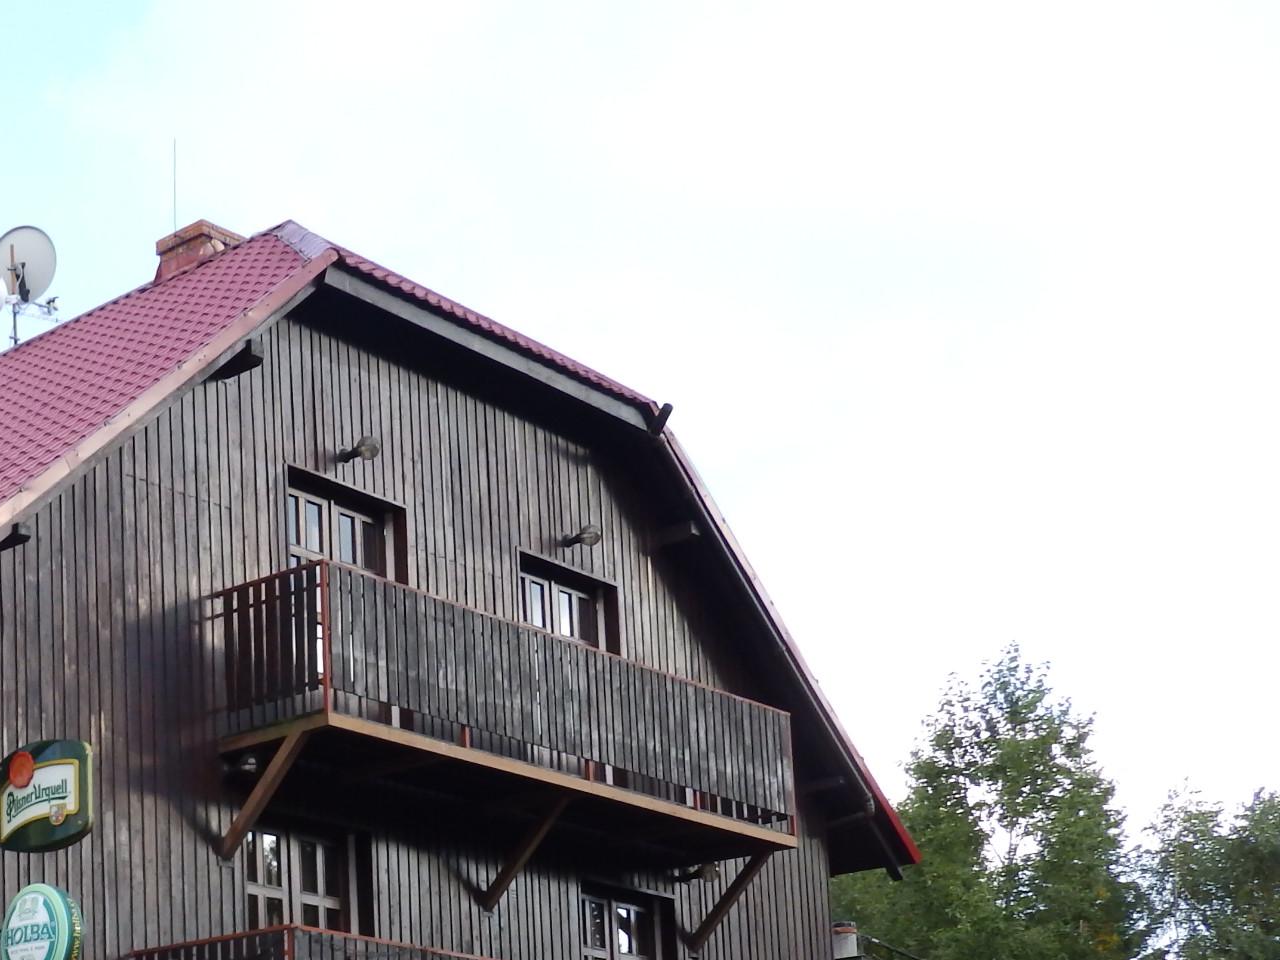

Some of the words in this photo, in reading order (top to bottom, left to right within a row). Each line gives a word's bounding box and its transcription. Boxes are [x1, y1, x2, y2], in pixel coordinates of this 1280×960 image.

[6, 791, 34, 824] Pilsner
[33, 778, 68, 803] Urquell
[5, 922, 55, 948] HOLBA
